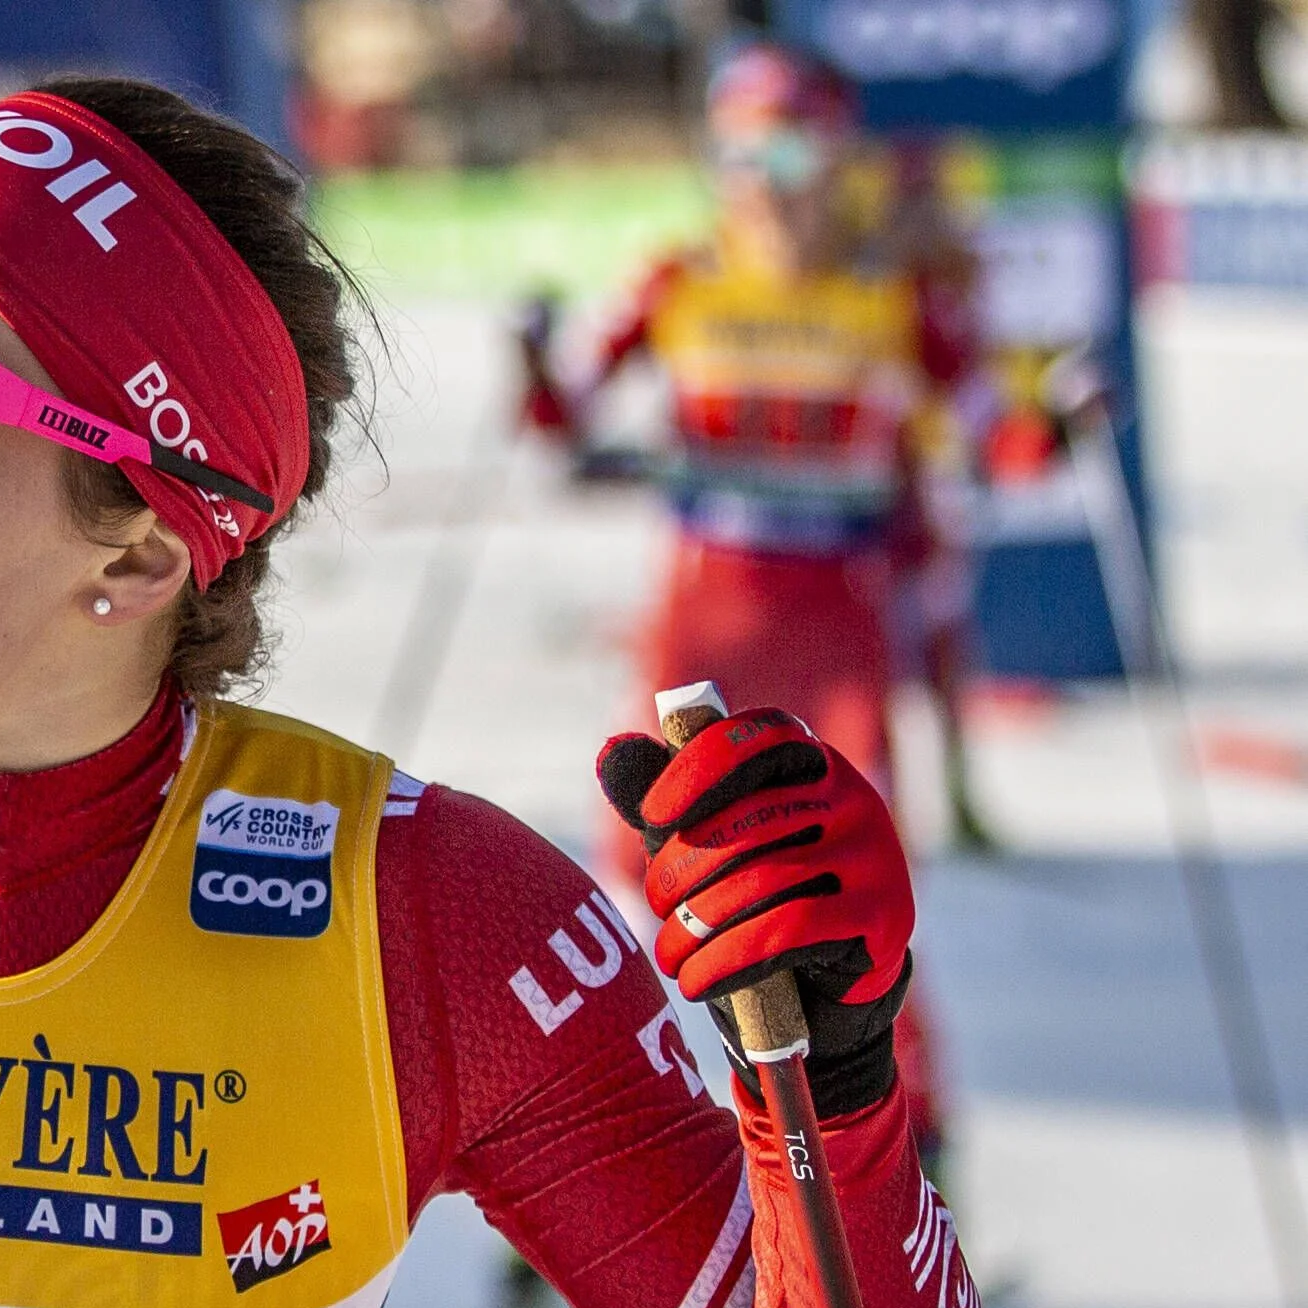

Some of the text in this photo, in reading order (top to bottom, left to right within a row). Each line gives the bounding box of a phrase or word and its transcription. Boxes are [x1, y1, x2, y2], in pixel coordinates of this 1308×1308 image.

[249, 807, 314, 828] CROSS
[246, 834, 295, 848] WORLD
[247, 820, 331, 841] COUNTRY
[198, 870, 327, 916] coop
[227, 1212, 327, 1275] AOP
